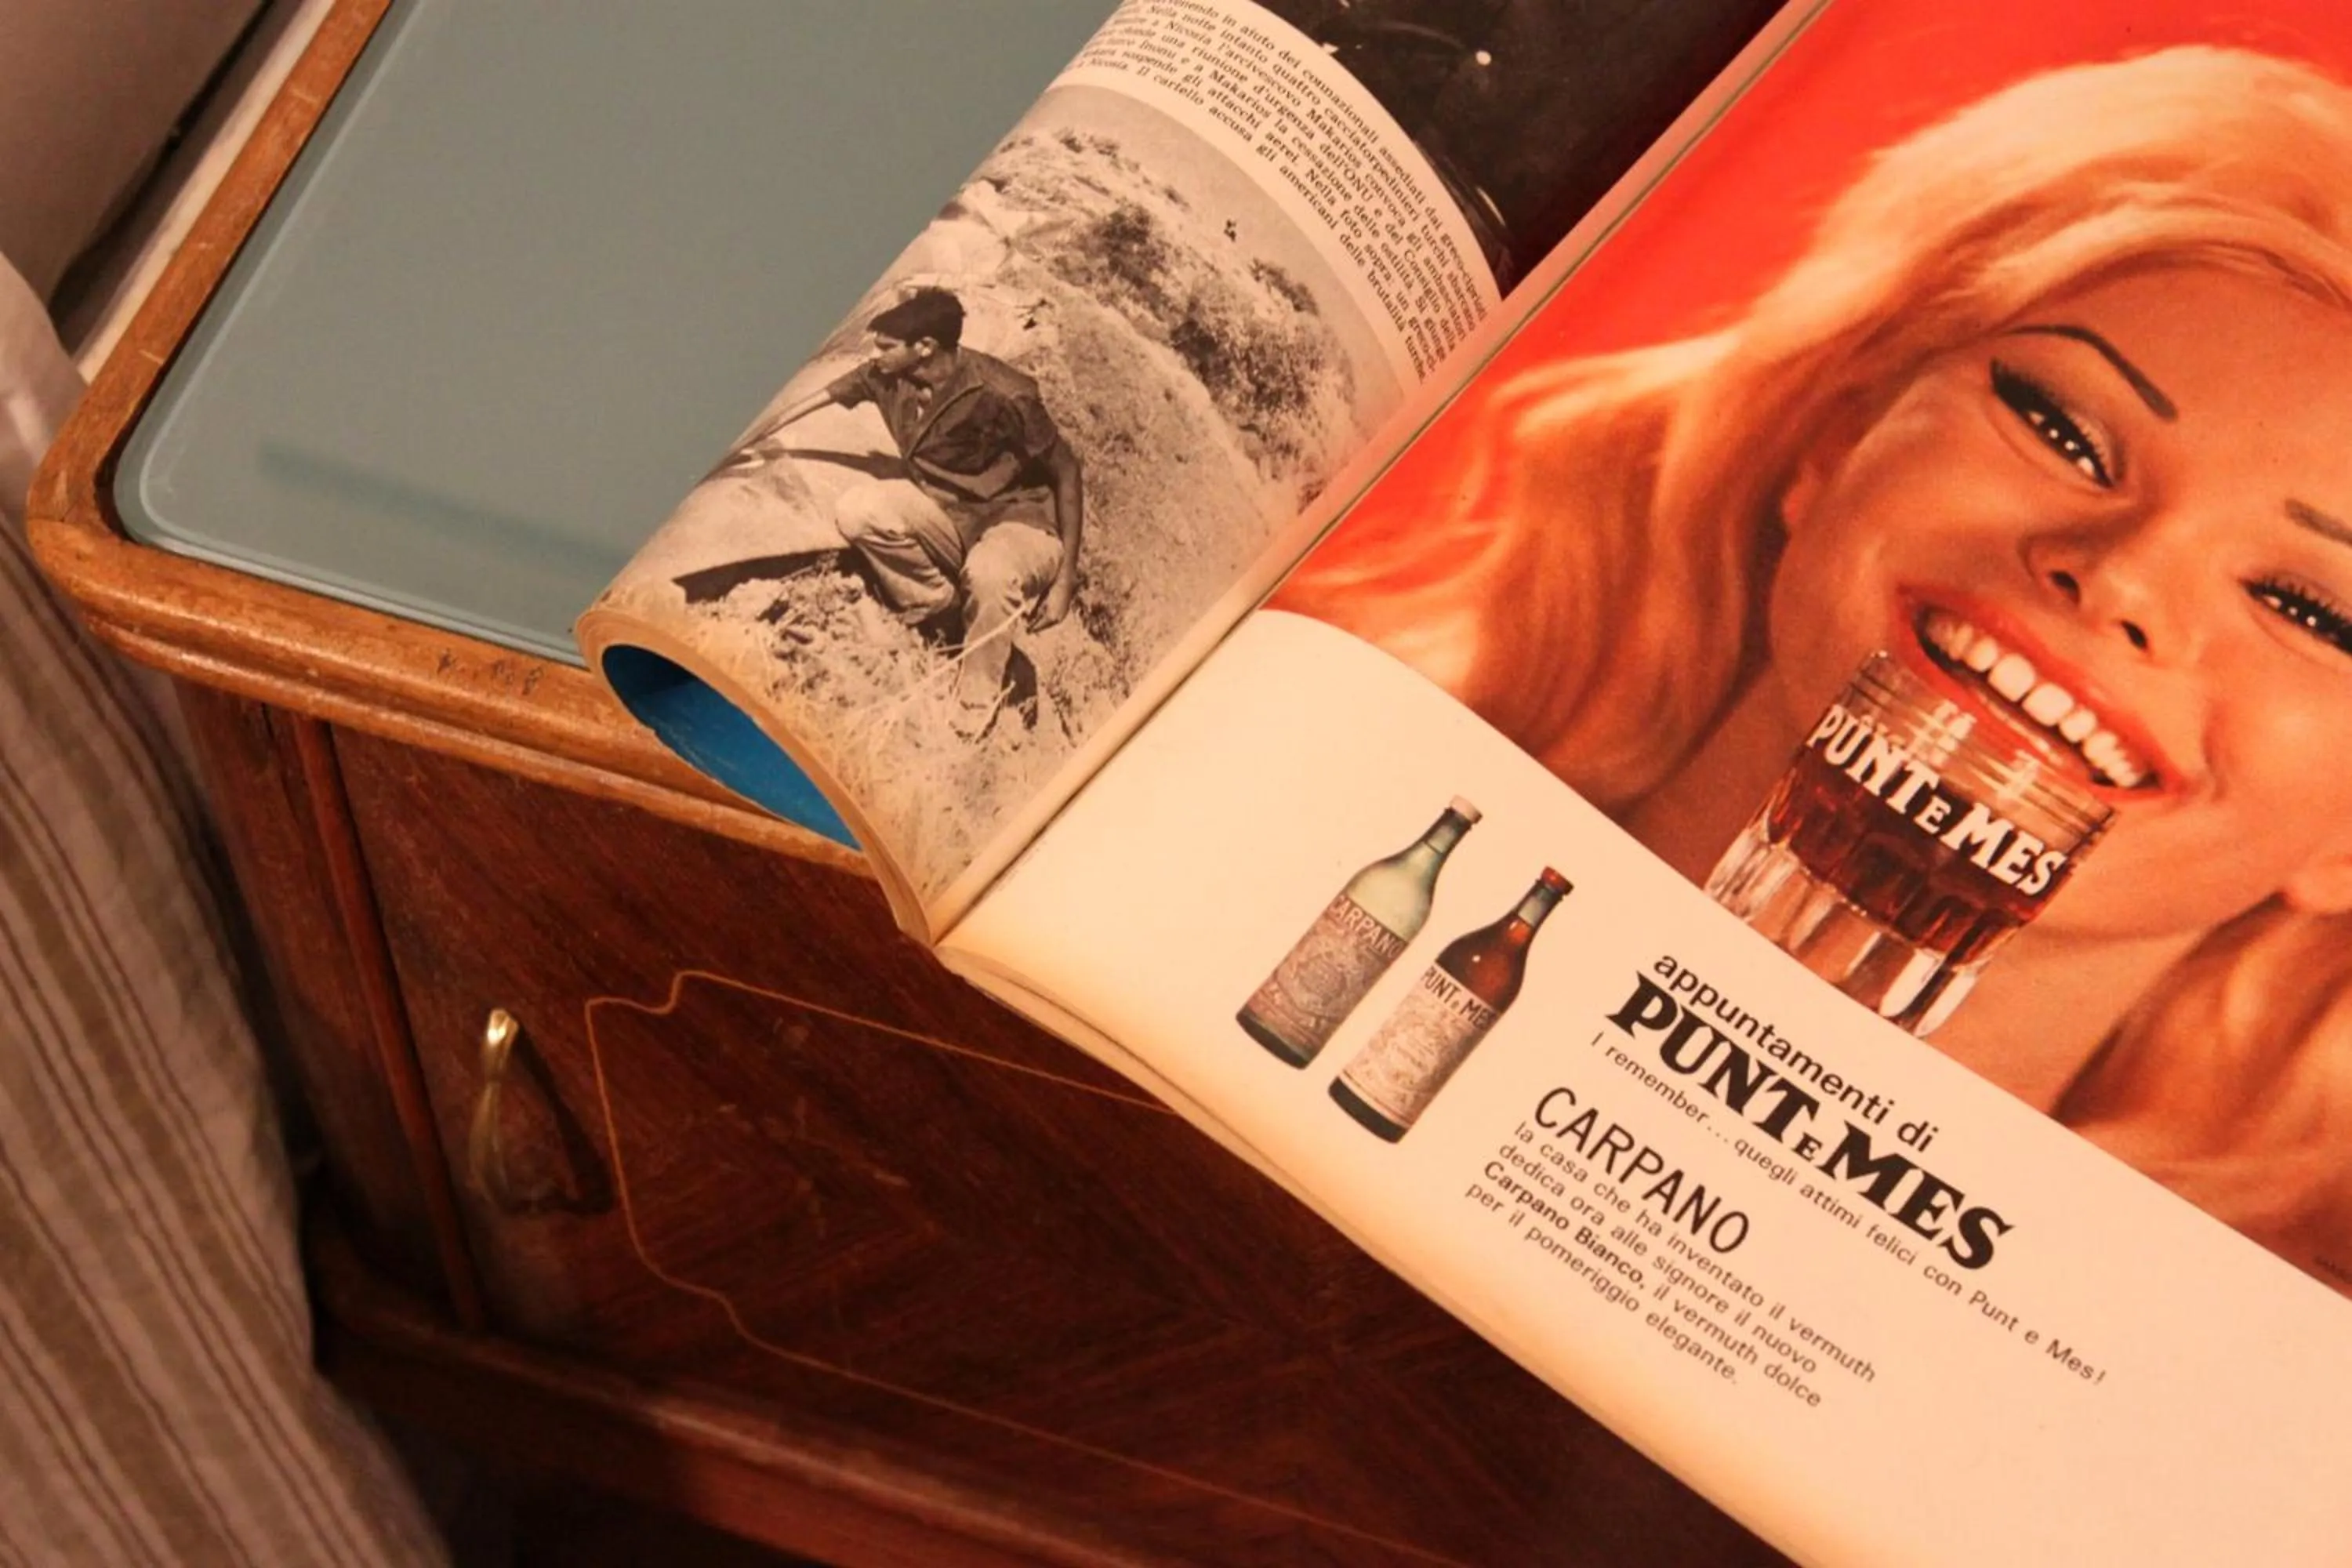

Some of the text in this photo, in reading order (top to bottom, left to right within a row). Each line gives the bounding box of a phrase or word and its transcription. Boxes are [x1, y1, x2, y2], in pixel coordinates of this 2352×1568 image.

[1121, 50, 1178, 73] sospende
[1181, 74, 1203, 88] gli
[1207, 88, 1262, 129] attacchi
[1305, 169, 1337, 206] Nella
[1340, 209, 1363, 238] foto
[1396, 292, 1410, 312] un
[1153, 75, 1205, 105] cartello
[1208, 106, 1253, 142] accusa
[1255, 144, 1279, 162] gli
[1279, 165, 1340, 230] americani
[1339, 234, 1366, 267] delle
[1367, 270, 1407, 332] brutalità
[1160, 34, 1186, 48] una
[1192, 46, 1249, 82] riunione
[1253, 84, 1316, 140] d'urgenza
[1319, 143, 1374, 201] dell'ONU
[1374, 208, 1383, 217] e
[1385, 223, 1404, 245] del
[1403, 249, 1441, 314] Consiglio
[1439, 318, 1456, 353] della
[1181, 14, 1216, 31] notte
[1220, 29, 1269, 64] intanto
[1272, 64, 1321, 105] quattro
[1324, 107, 1421, 223] cacciatorpedinieri
[1421, 224, 1450, 268] turchi
[1446, 273, 1475, 332] sbarcano
[1193, 64, 1204, 73] a
[1208, 70, 1272, 118] Makarios
[1274, 118, 1289, 135] la
[1292, 136, 1352, 201] cessazione
[1353, 205, 1381, 238] delle
[1415, 296, 1428, 314] Si
[1217, 42, 1301, 107] l'arcivescovo
[1306, 108, 1362, 168] Makarios
[1365, 172, 1406, 227] convoca
[1406, 232, 1423, 252] gli
[1424, 257, 1466, 342] ambasciatori
[1221, 14, 1237, 27] in
[1240, 26, 1275, 50] aiuto
[1279, 50, 1301, 68] dei
[1302, 70, 1379, 143] connazionali
[1379, 147, 1426, 204] assediati
[1425, 206, 1443, 230] dai
[1806, 704, 1940, 815] PUNT
[1939, 801, 2068, 895] MES
[1331, 895, 1405, 958] CARPANO
[1420, 966, 1462, 1004] PUNT
[1534, 1087, 1750, 1254] CARPANO
[1604, 970, 1820, 1144] PUNT
[1814, 1120, 2016, 1270] MES
[1653, 955, 1940, 1153] appuntamenti di
[1464, 1182, 1738, 1385] per il pomeriggio elegante.
[1483, 1161, 1822, 1408] Carpano Bianco, il vermuth dolce
[1498, 1145, 1817, 1374] dedica ora alle signore il nuovo
[1513, 1121, 1876, 1383] la casa che ha inventato il vermuth
[1590, 1031, 1604, 1046] I
[1734, 1138, 1798, 1185] quegli
[1799, 1183, 1864, 1229] attimi
[1865, 1224, 1919, 1266] felici
[1923, 1265, 1963, 1296] con
[1968, 1290, 2020, 1332] Punt
[2024, 1330, 2040, 1345] e
[2045, 1338, 2107, 1385] Mes!
